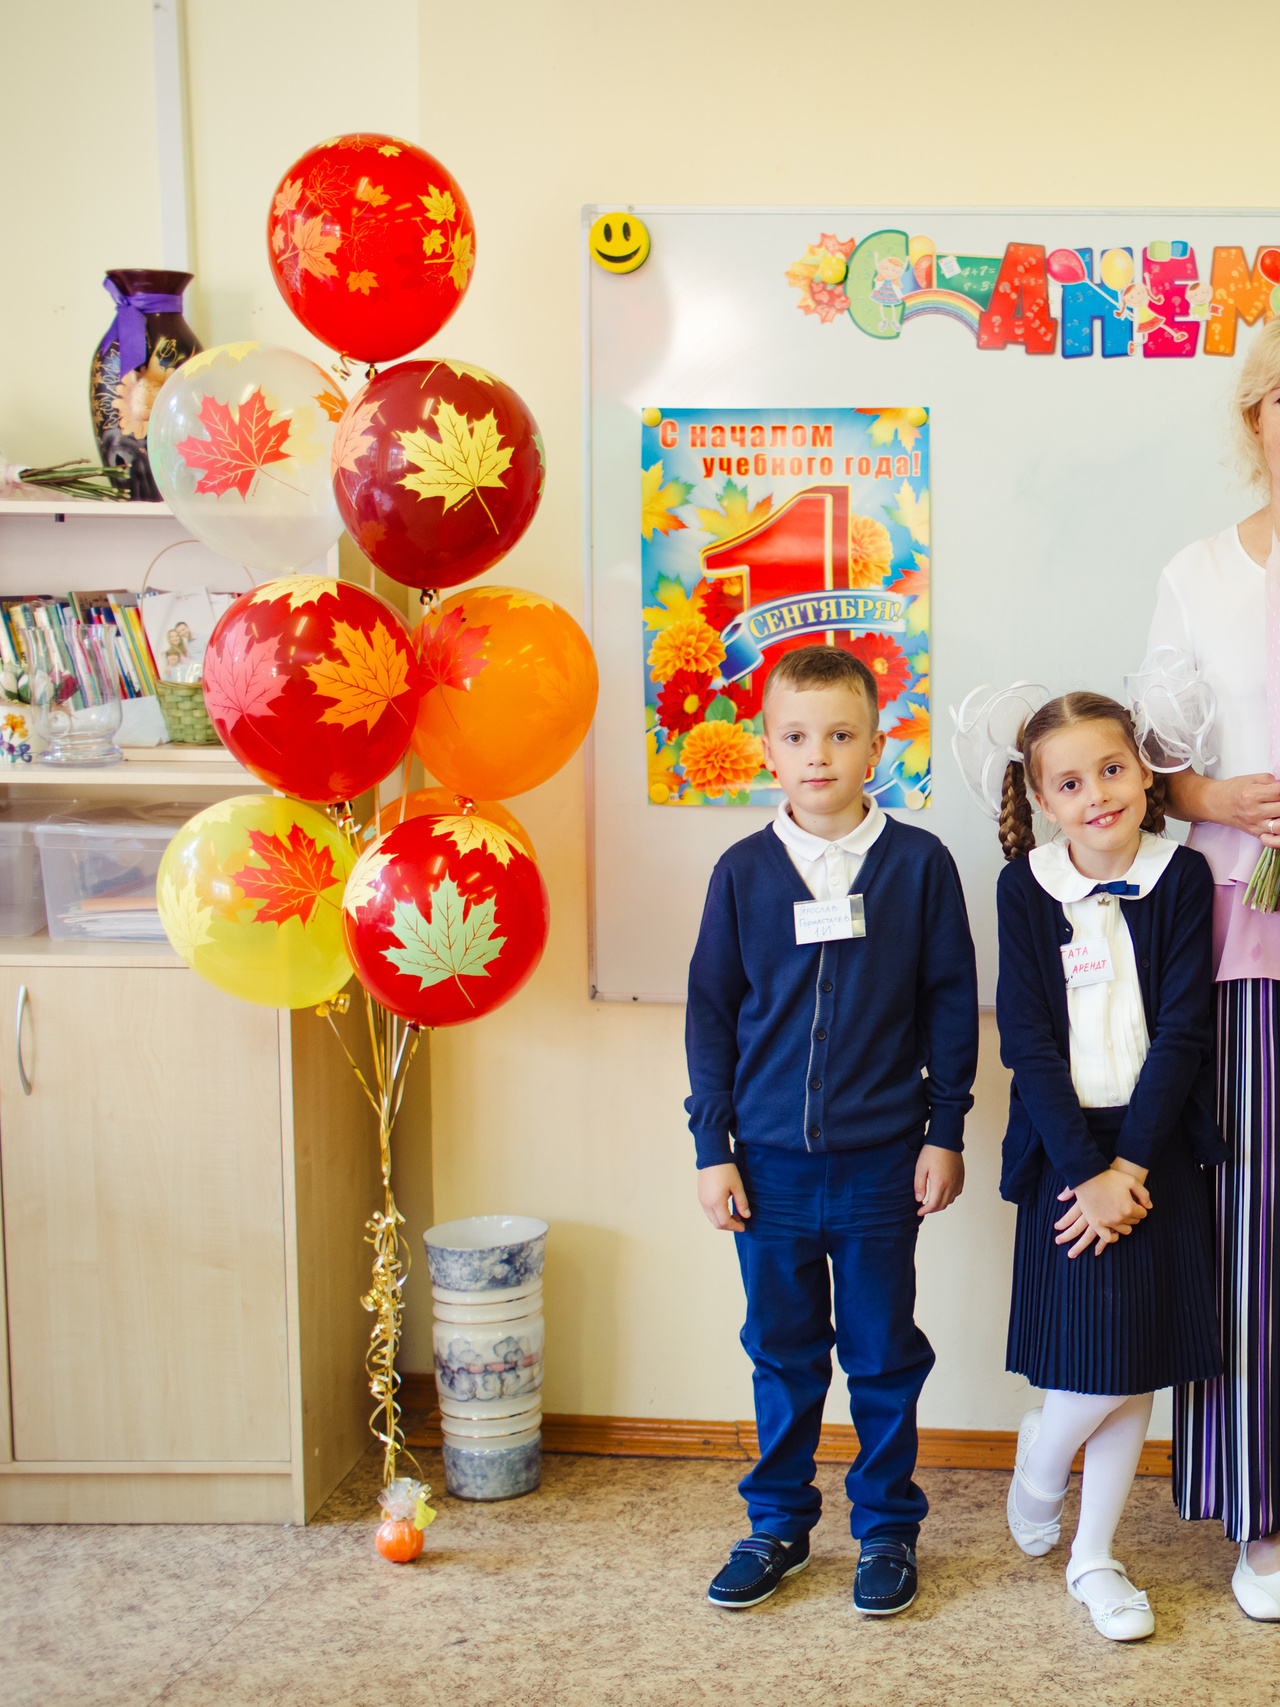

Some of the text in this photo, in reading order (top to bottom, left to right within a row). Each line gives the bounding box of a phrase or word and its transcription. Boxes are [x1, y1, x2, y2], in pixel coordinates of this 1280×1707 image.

[844, 229, 909, 341] С
[659, 420, 834, 449] С началом
[702, 451, 922, 480] учебного года!
[749, 597, 902, 639] СЕНТЯБРЯ!
